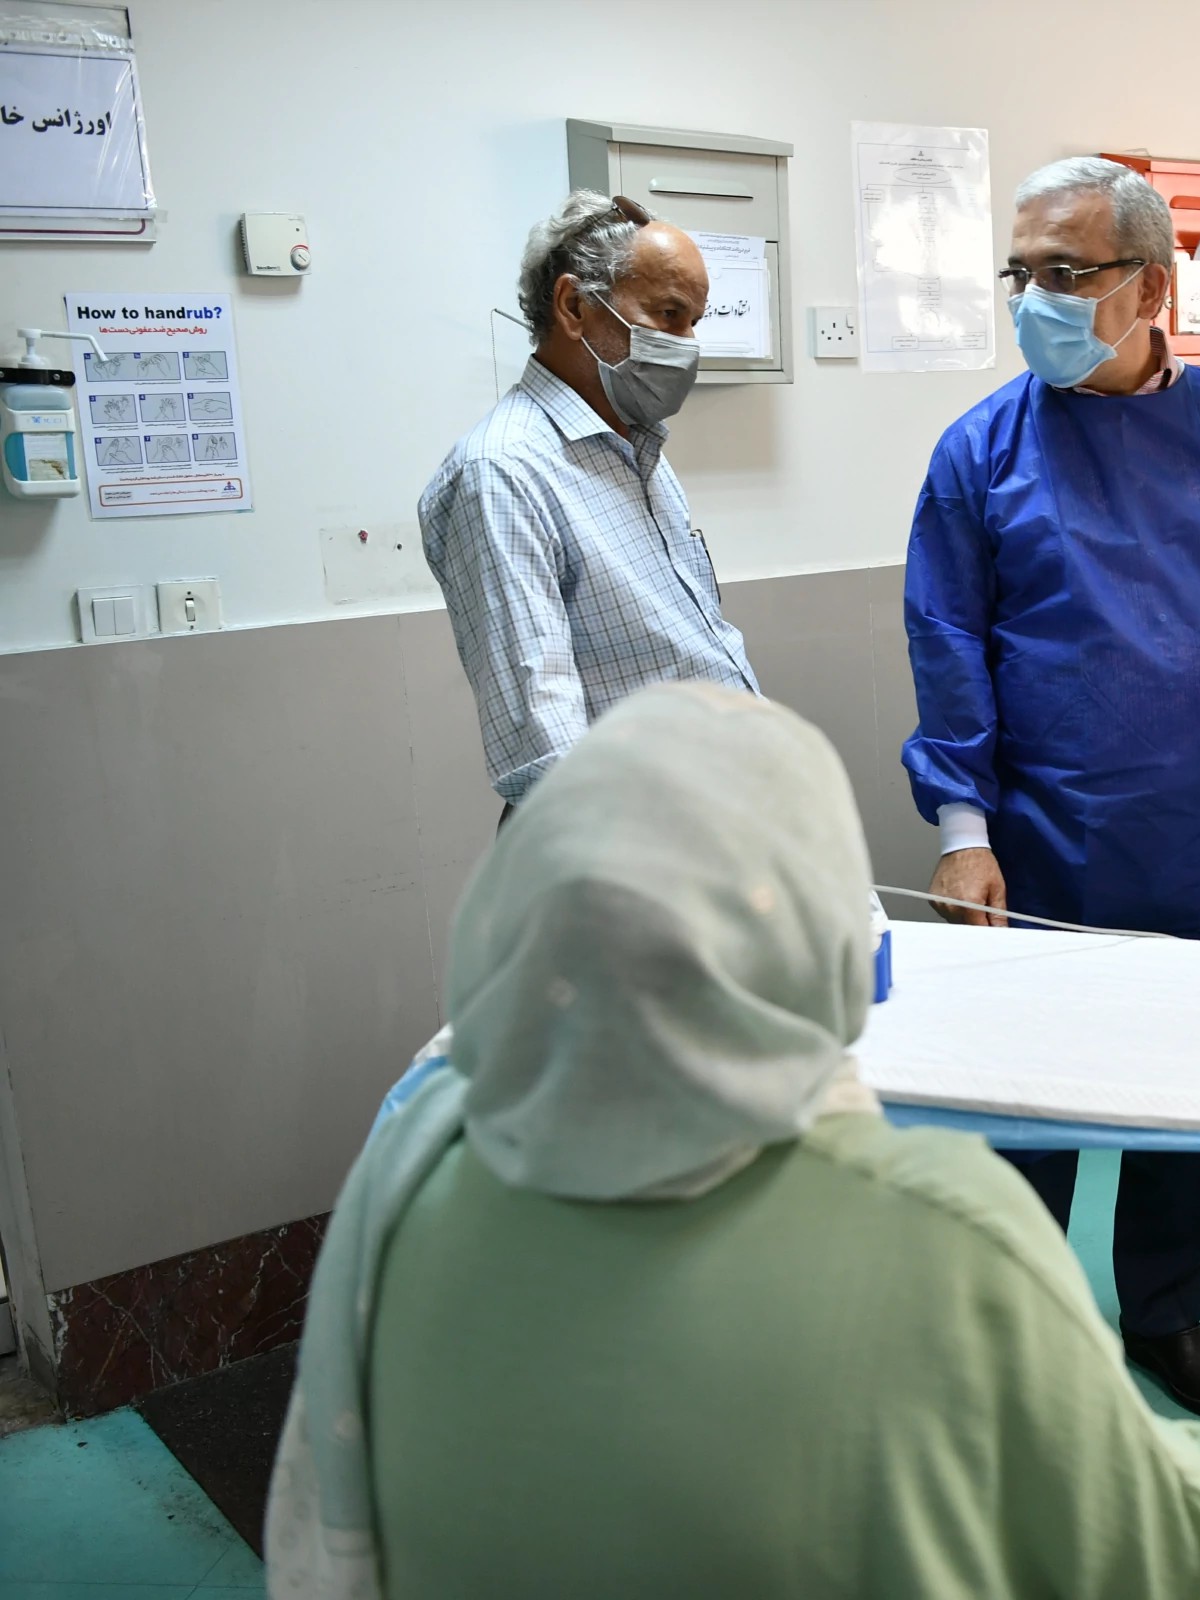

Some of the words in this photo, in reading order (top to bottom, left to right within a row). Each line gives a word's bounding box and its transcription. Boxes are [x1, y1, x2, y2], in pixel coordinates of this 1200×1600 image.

[32, 108, 112, 135] اورژانس
[78, 306, 116, 319] How
[122, 306, 139, 319] to
[144, 306, 222, 319] handrub?
[718, 300, 750, 316] انتقادات
